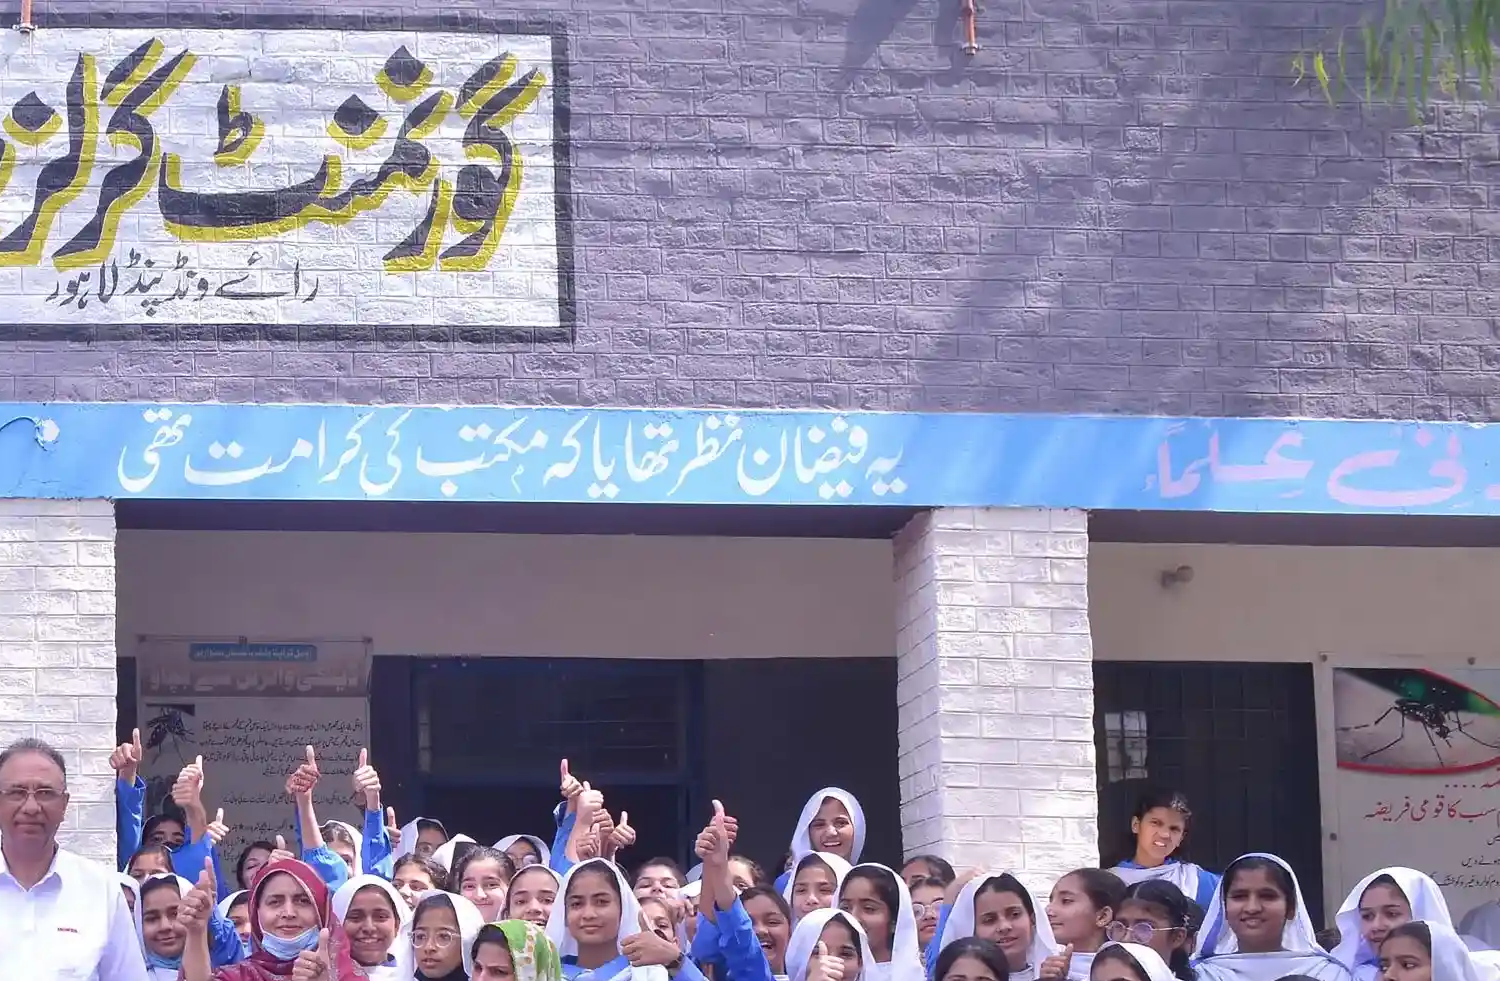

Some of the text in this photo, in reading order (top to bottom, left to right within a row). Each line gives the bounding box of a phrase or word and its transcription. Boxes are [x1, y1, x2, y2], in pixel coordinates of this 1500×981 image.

[160, 46, 545, 272] گورنمنٹ
[46, 258, 118, 309] لاہور
[116, 407, 194, 494] تھی
[185, 413, 366, 484] کرامت
[361, 412, 412, 496] کی
[625, 419, 680, 483] تھا
[667, 414, 744, 497] نظر
[737, 416, 868, 499] فیضان
[866, 446, 908, 497] یہ
[1411, 794, 1445, 822] قومی
[1447, 799, 1461, 819] کا
